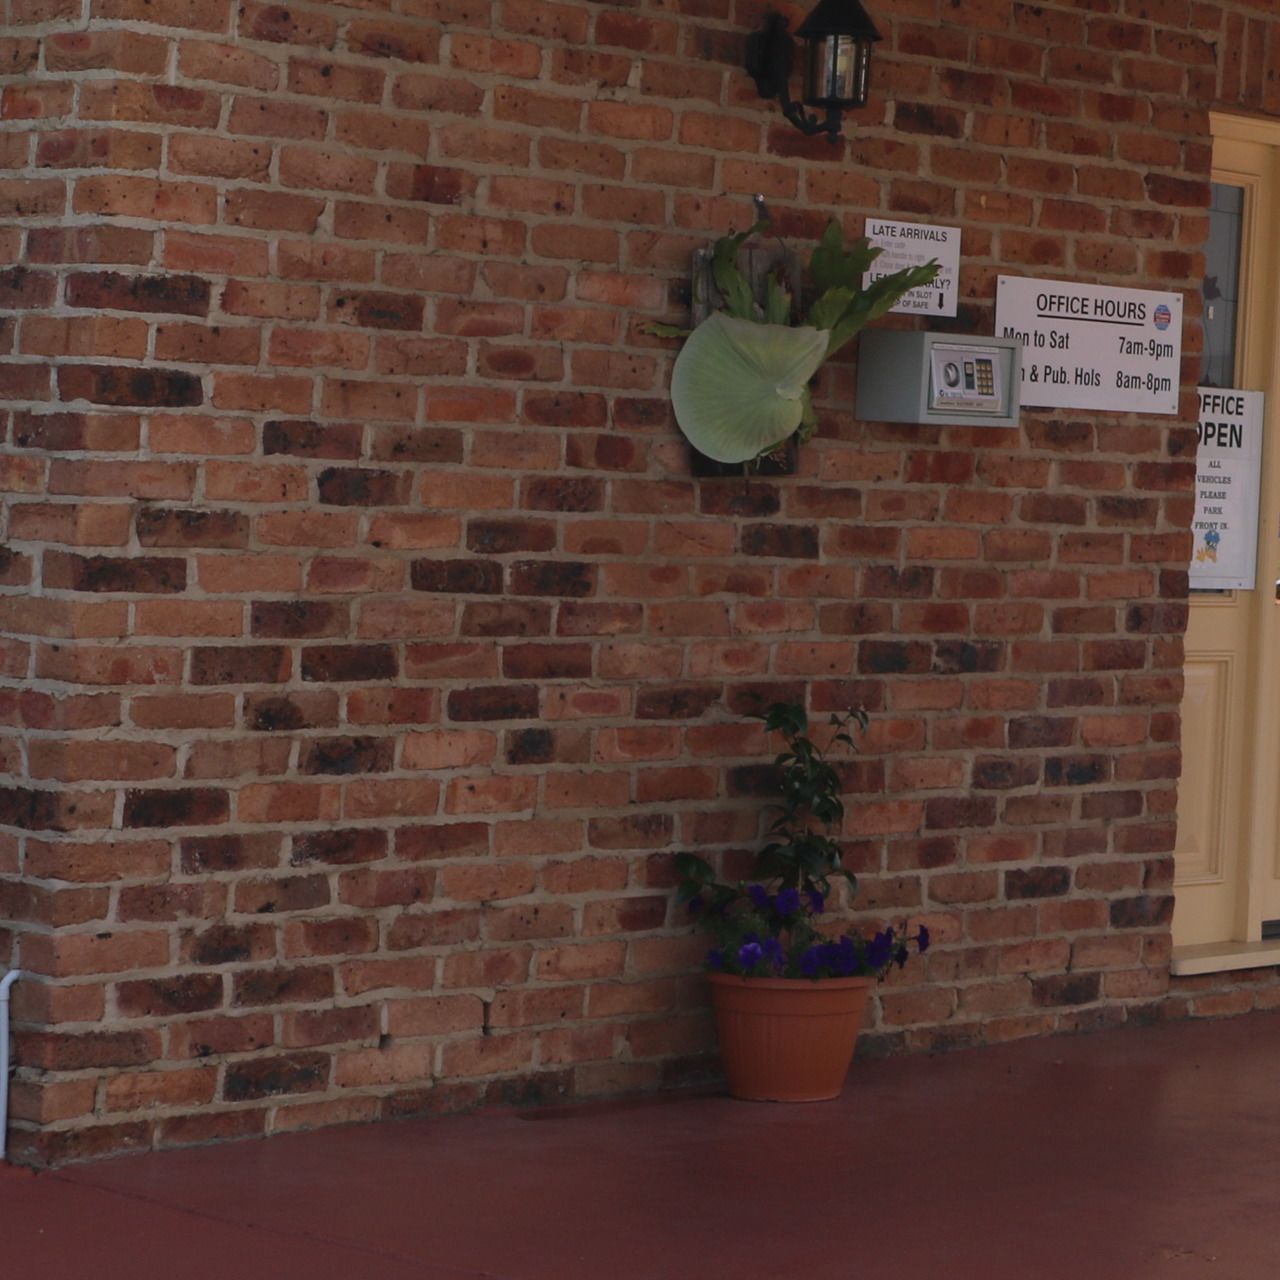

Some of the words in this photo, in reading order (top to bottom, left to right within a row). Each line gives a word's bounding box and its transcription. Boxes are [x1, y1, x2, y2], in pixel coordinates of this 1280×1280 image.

[872, 224, 896, 237] LATE
[899, 227, 948, 242] ARRIVALS
[916, 291, 932, 299] SLOT
[912, 301, 929, 309] SAFE
[1036, 293, 1090, 315] OFFICE
[1094, 298, 1147, 320] HOURS
[1033, 330, 1045, 348] to
[1050, 330, 1070, 350] Sat
[1118, 336, 1173, 360] 7am-9pm
[1030, 364, 1039, 382] &
[1043, 365, 1070, 385] Pub.
[1074, 367, 1101, 387] Hols
[1116, 370, 1171, 395] 8am-8pm
[1199, 393, 1245, 416] FFICE
[1198, 422, 1243, 448] PEN
[1208, 461, 1221, 469] ALL
[1197, 475, 1231, 484] VEHICLES
[1200, 491, 1227, 499] PLEASE
[1203, 506, 1223, 515] PARK
[1195, 522, 1218, 530] FRONT
